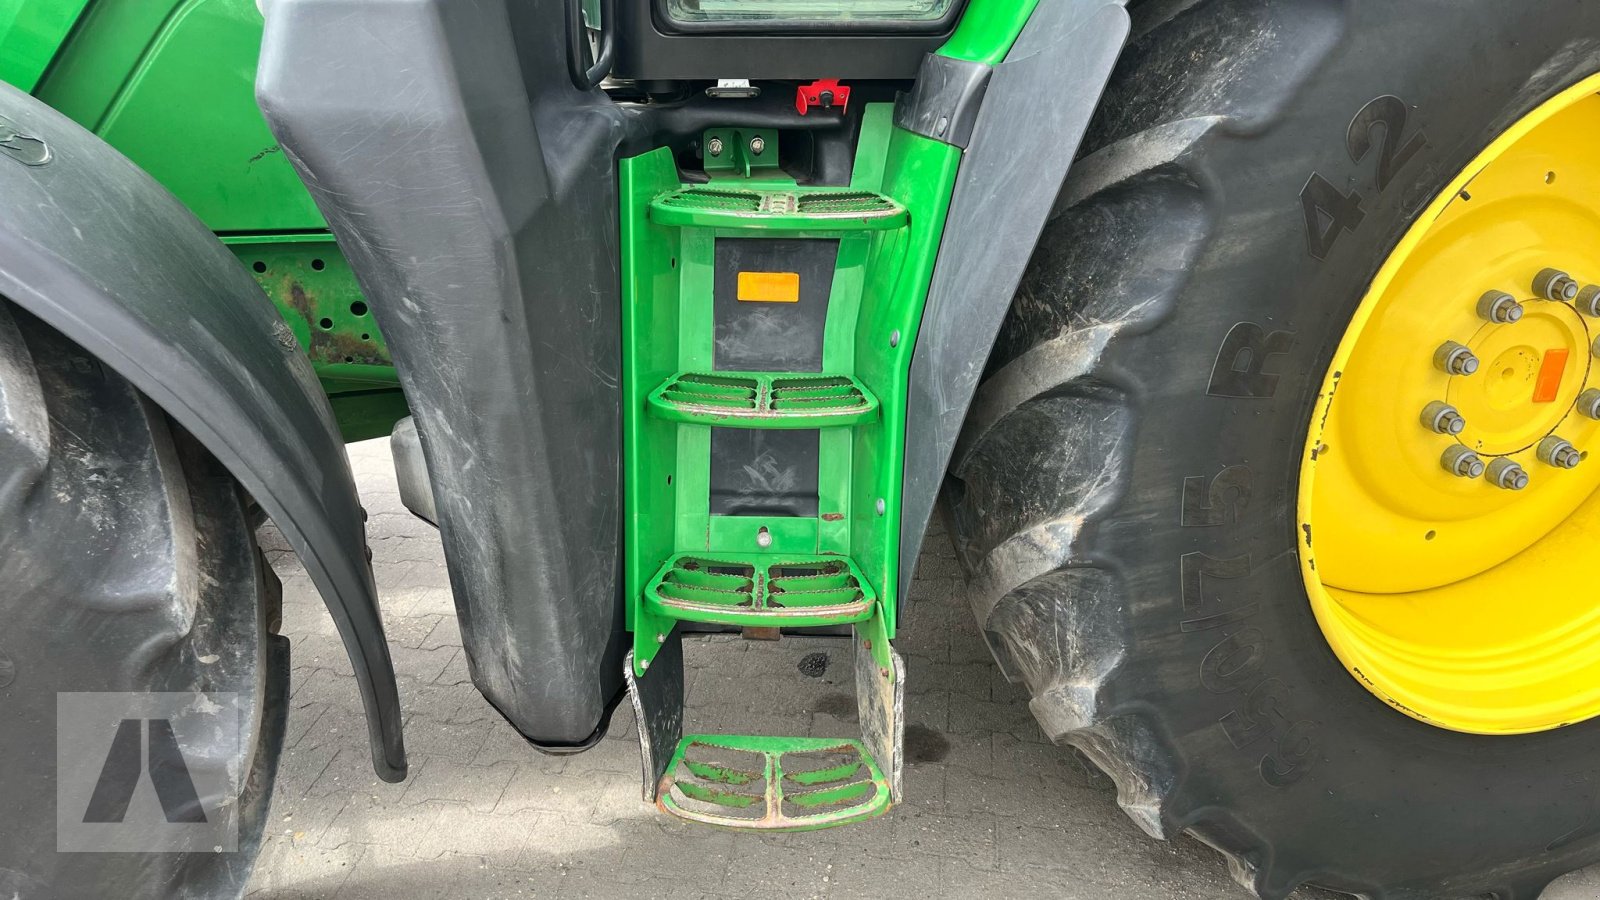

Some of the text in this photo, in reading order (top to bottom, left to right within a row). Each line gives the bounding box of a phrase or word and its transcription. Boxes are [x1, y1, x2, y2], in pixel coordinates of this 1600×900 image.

[1180, 94, 1429, 788] 650/75 R 42
